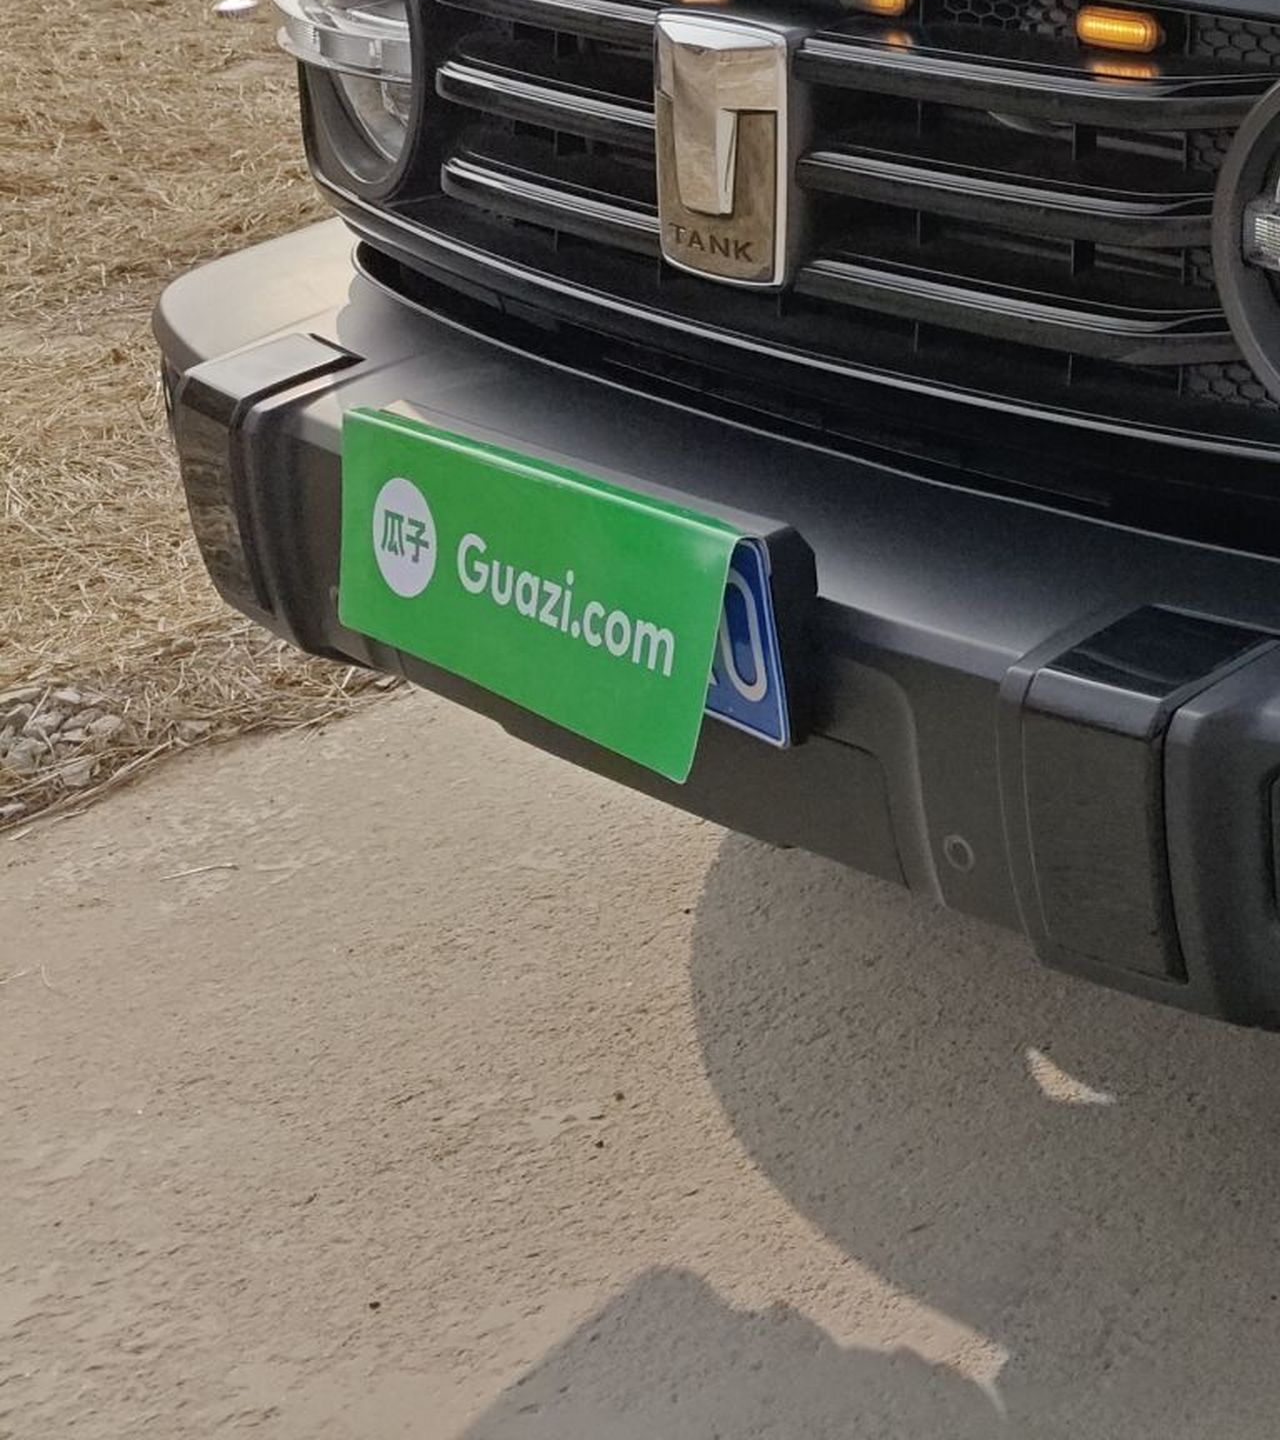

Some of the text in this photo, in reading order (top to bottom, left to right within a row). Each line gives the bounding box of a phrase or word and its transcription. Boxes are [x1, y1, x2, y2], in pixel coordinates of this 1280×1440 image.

[669, 222, 753, 262] TANK
[382, 509, 430, 564] 瓜子
[456, 532, 676, 677] Guazi.com
